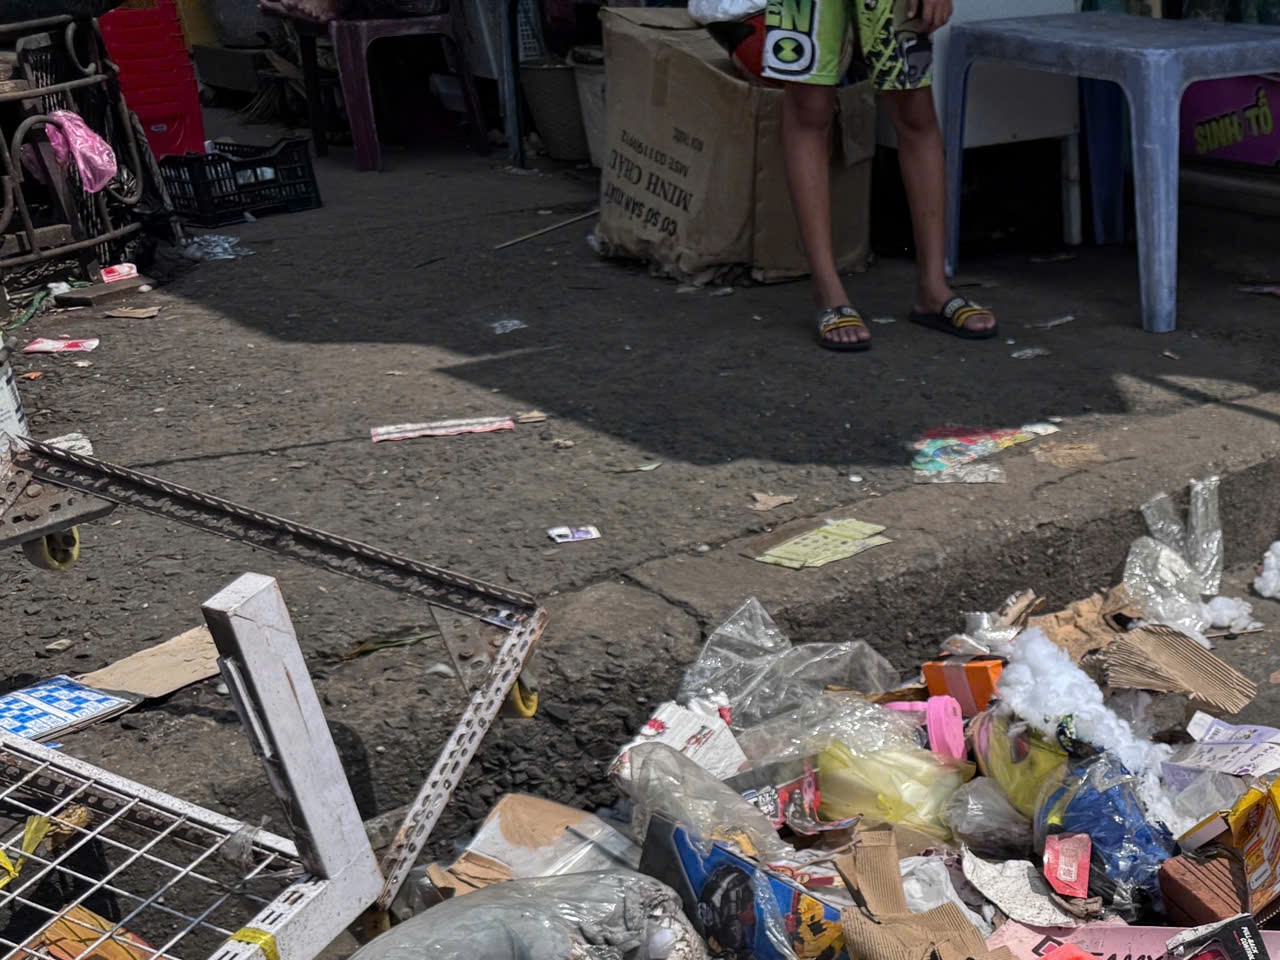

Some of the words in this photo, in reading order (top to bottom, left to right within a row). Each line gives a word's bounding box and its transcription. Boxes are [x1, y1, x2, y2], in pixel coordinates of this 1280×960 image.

[1194, 113, 1243, 154] SINH
[646, 172, 694, 213] MINH
[658, 216, 678, 237] CƠ
